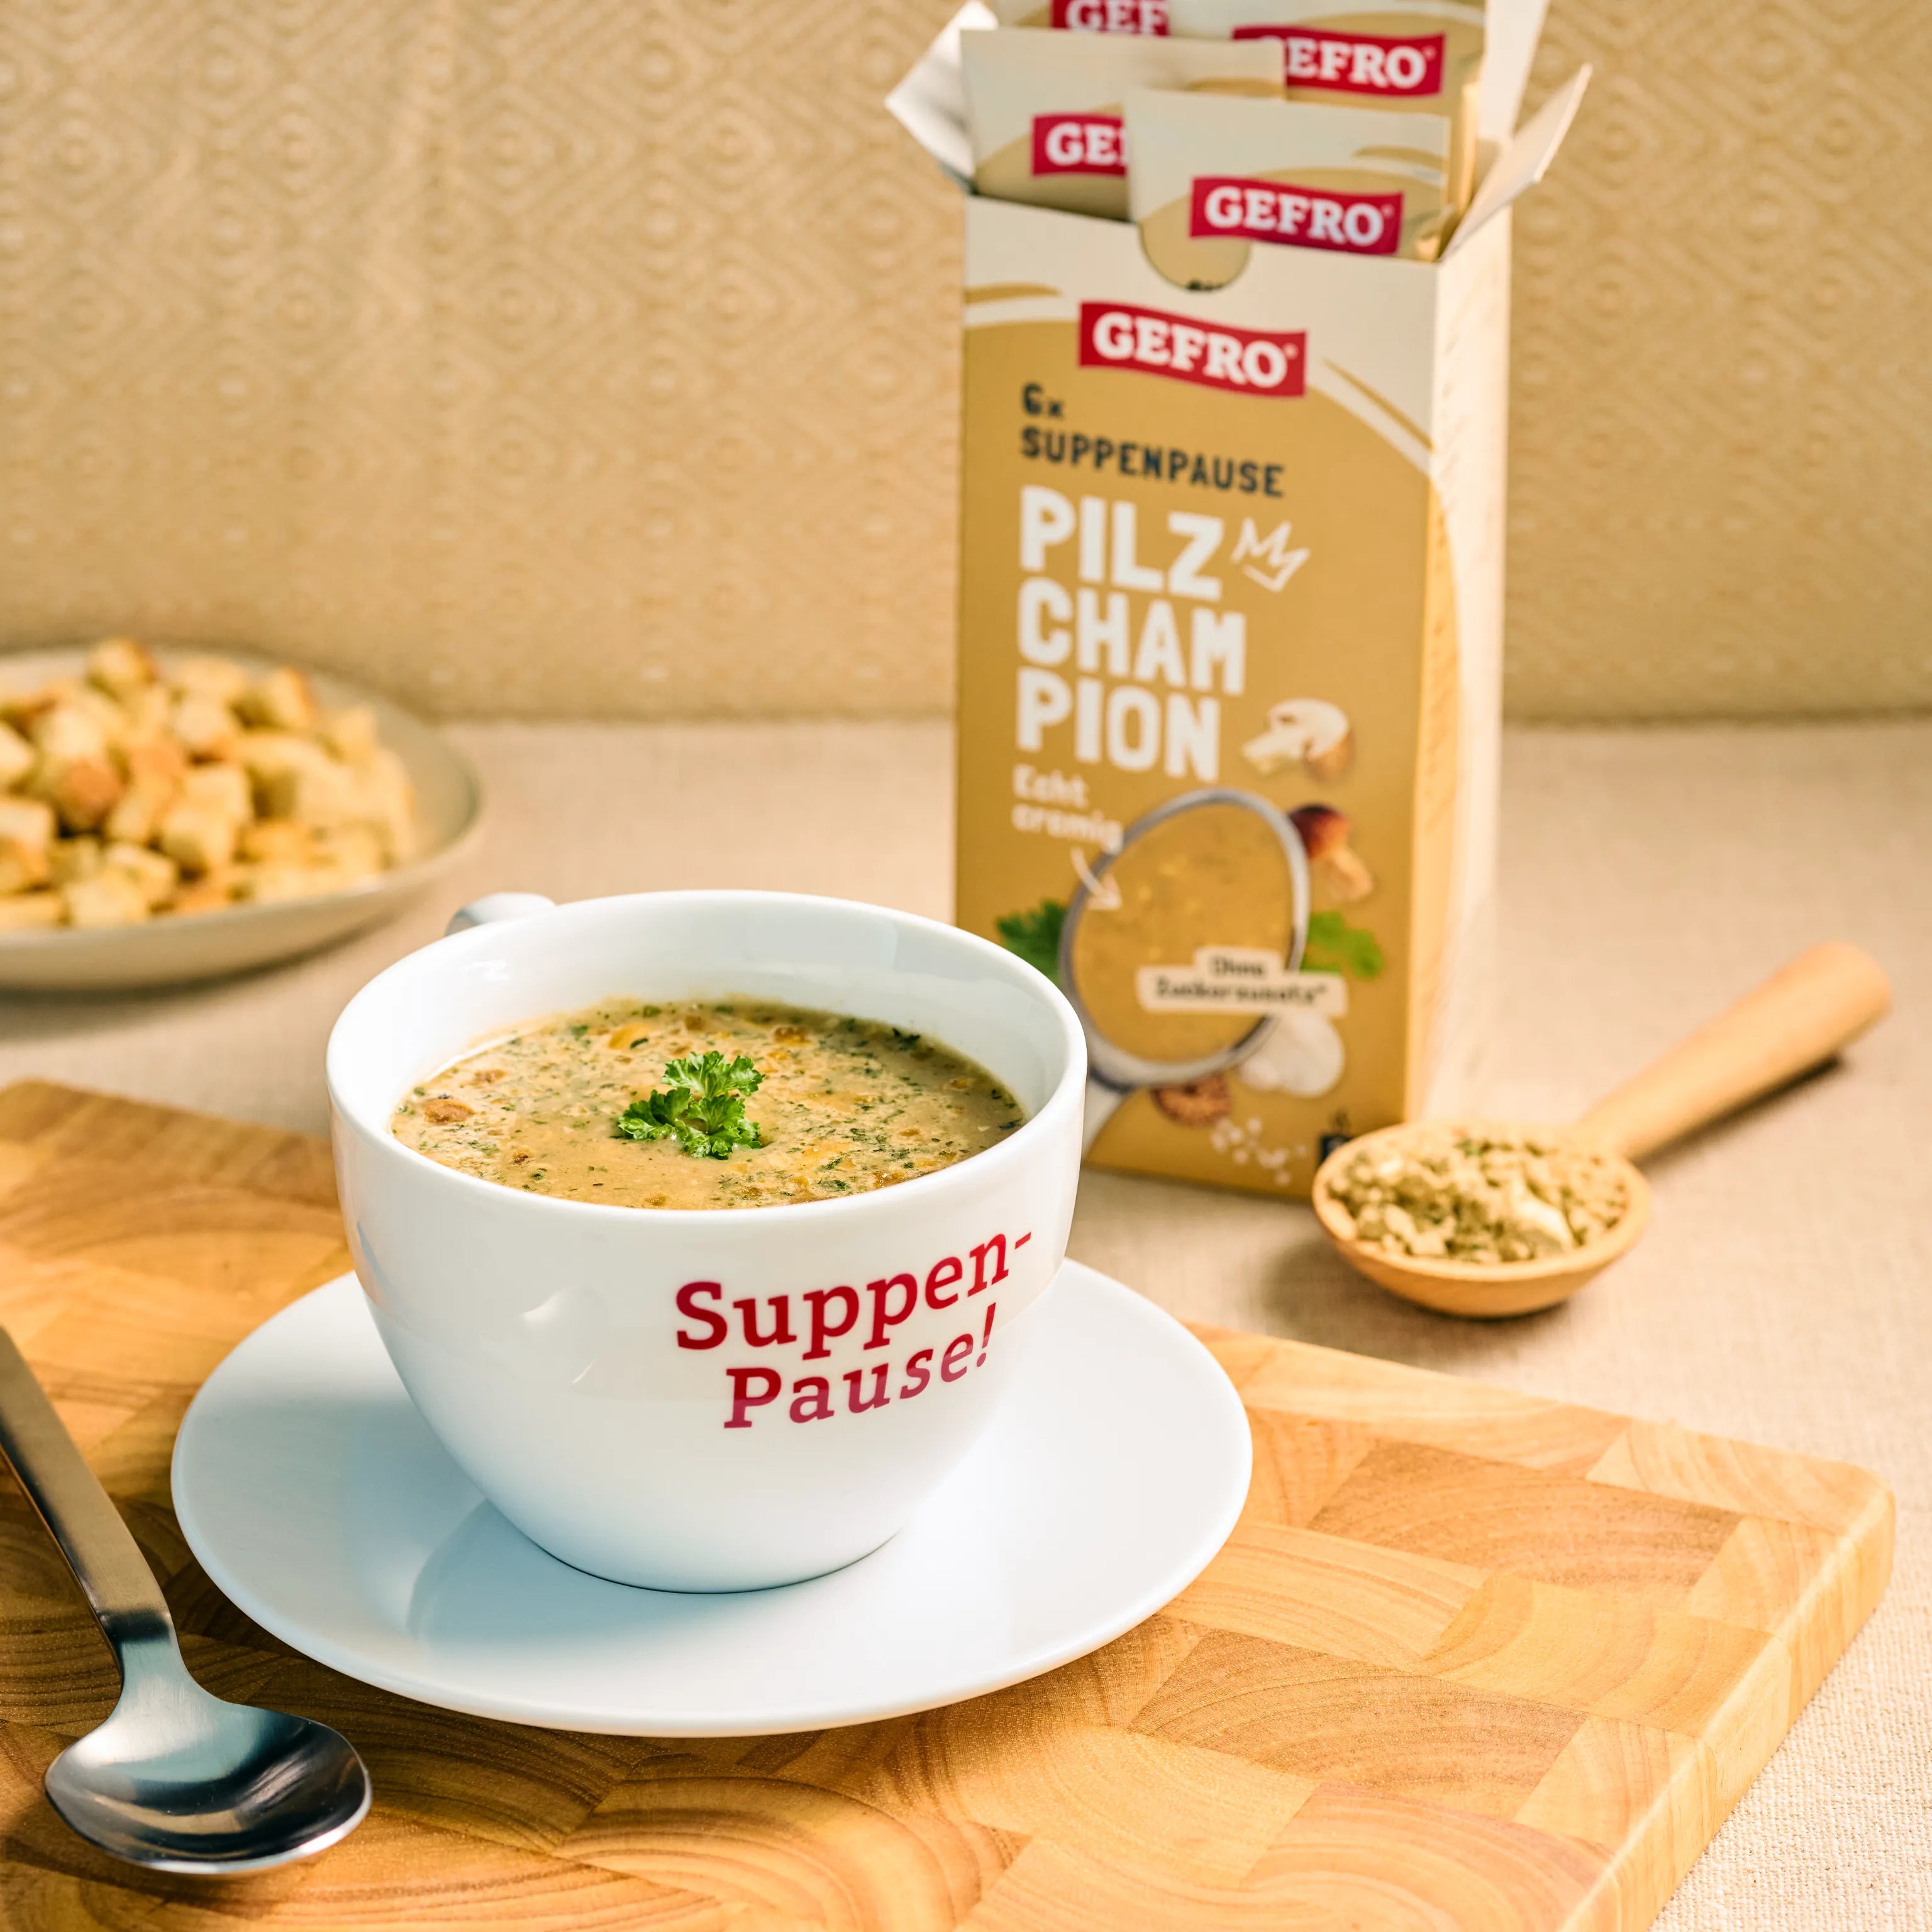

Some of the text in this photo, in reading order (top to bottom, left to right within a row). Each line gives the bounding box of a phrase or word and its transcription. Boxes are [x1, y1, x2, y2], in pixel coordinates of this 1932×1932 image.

[1258, 35, 1426, 89] EFRO
[1205, 186, 1384, 246] GEFRO
[1092, 312, 1288, 388] GEFRO
[1021, 383, 1064, 420] 6x
[1021, 426, 1285, 497] SUPPENPAUSE
[1020, 486, 1224, 602] PILZ
[1018, 577, 1247, 694] CHAM
[1016, 668, 1220, 782] PION
[675, 1231, 1032, 1360] Suppen-
[723, 1301, 997, 1430] Pause!
